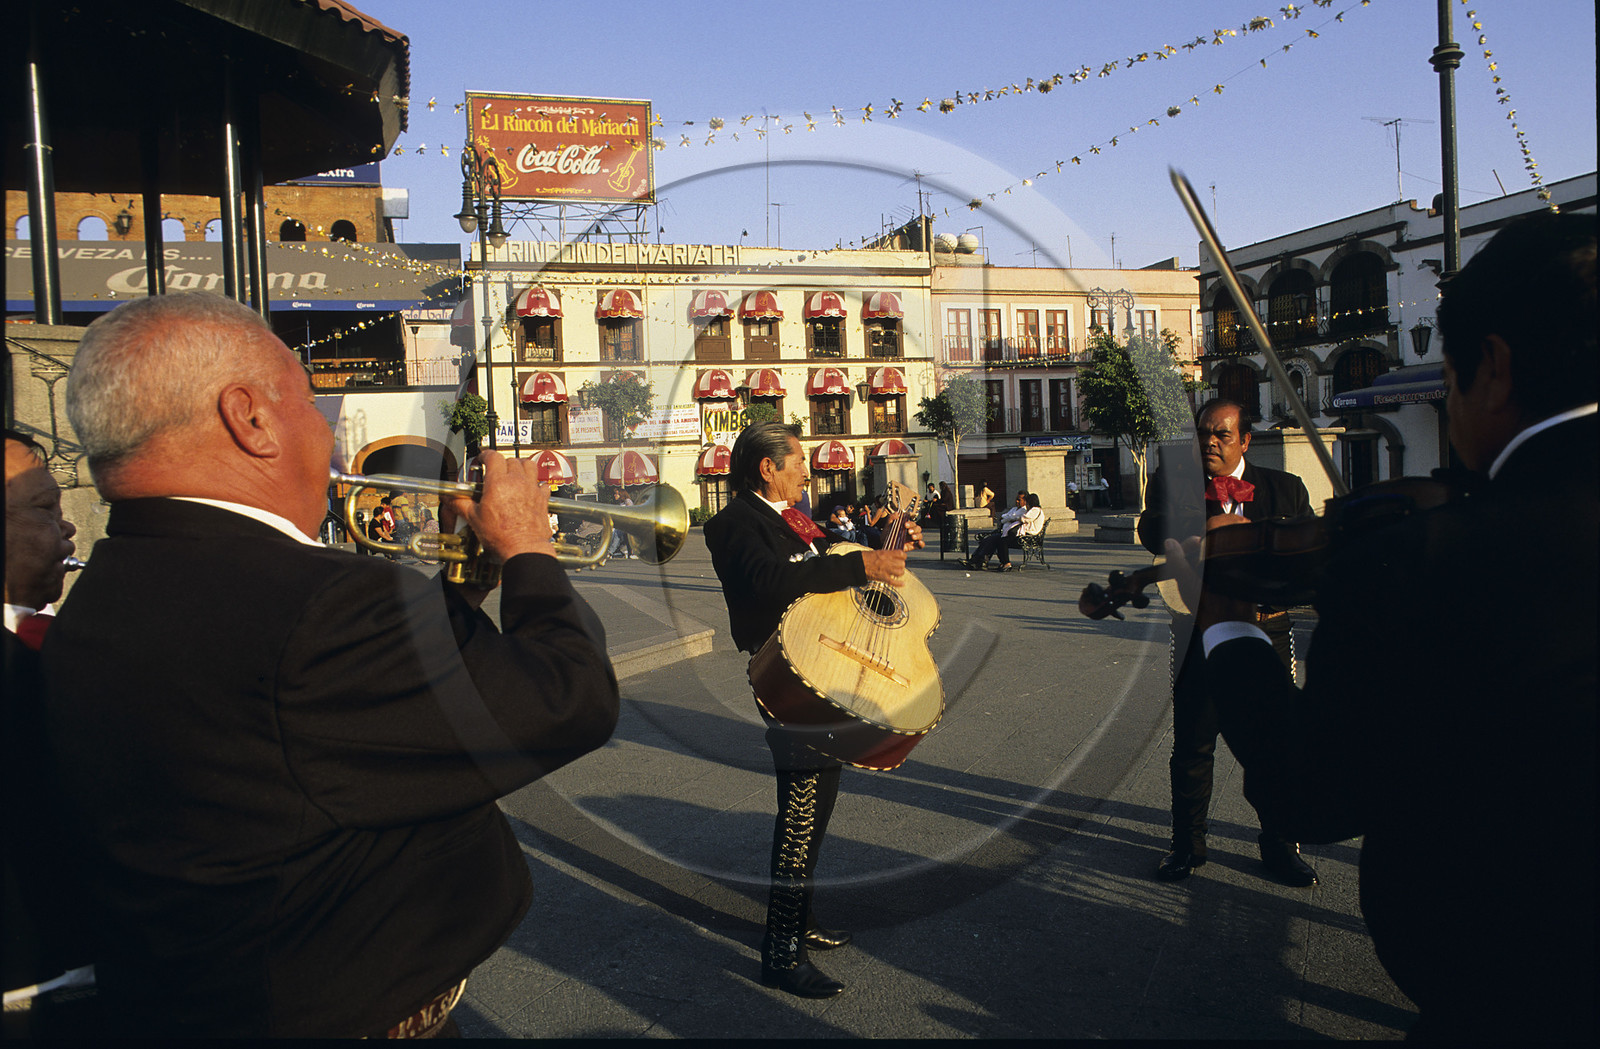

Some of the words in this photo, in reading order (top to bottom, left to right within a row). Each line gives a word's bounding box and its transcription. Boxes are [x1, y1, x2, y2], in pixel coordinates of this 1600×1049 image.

[480, 113, 499, 130] El
[556, 116, 579, 132] del
[582, 118, 639, 137] Mariachi
[516, 142, 605, 176] Coca-Cola
[6, 246, 135, 260] EVEZA
[107, 264, 329, 294] Corna
